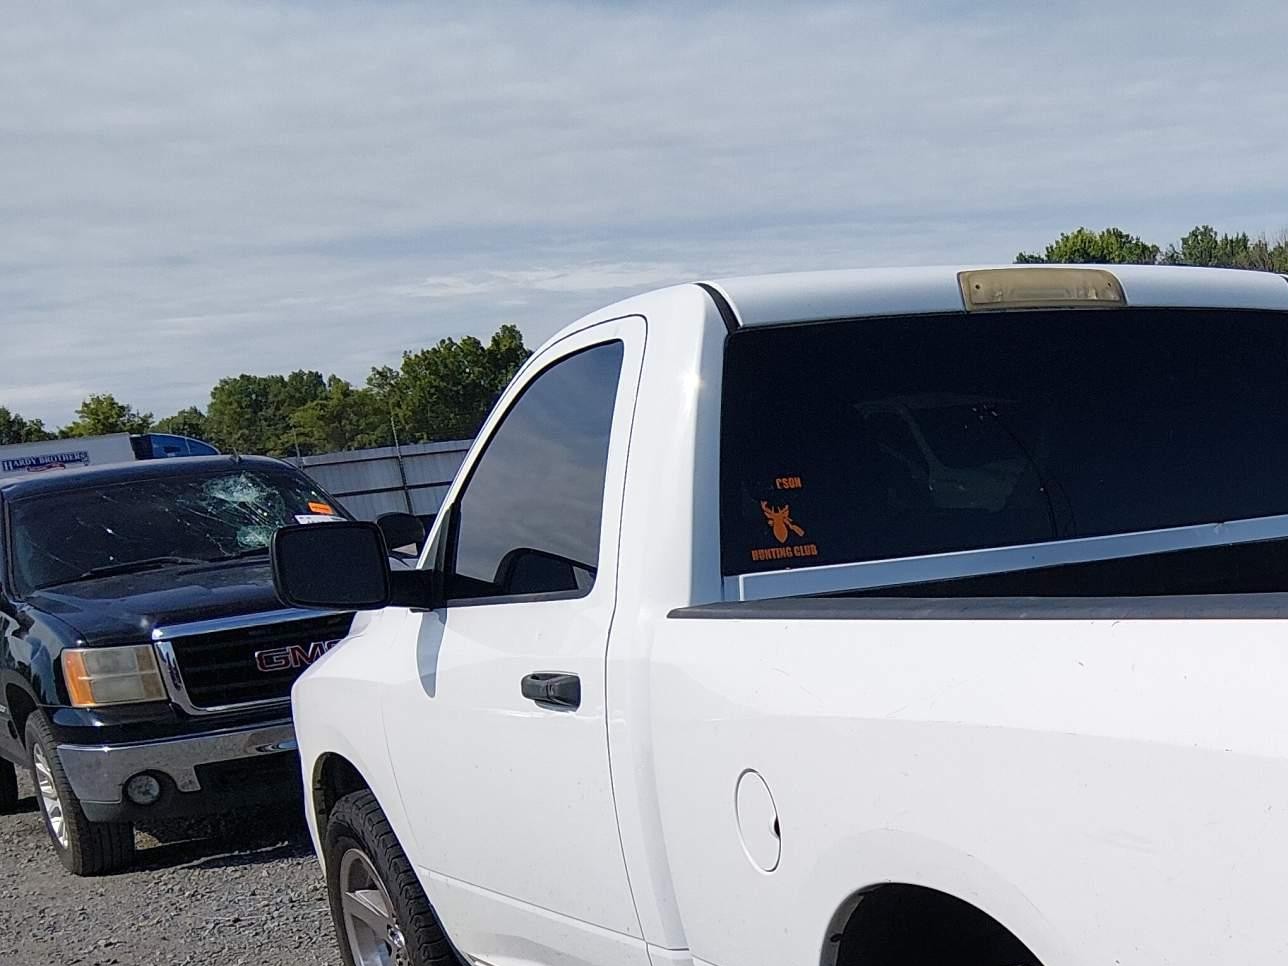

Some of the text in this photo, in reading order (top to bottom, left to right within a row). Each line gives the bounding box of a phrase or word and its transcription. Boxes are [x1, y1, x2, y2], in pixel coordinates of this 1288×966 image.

[4, 457, 37, 471] HARDY
[752, 543, 818, 561] HUNTING CLUB
[255, 639, 342, 672] GM
